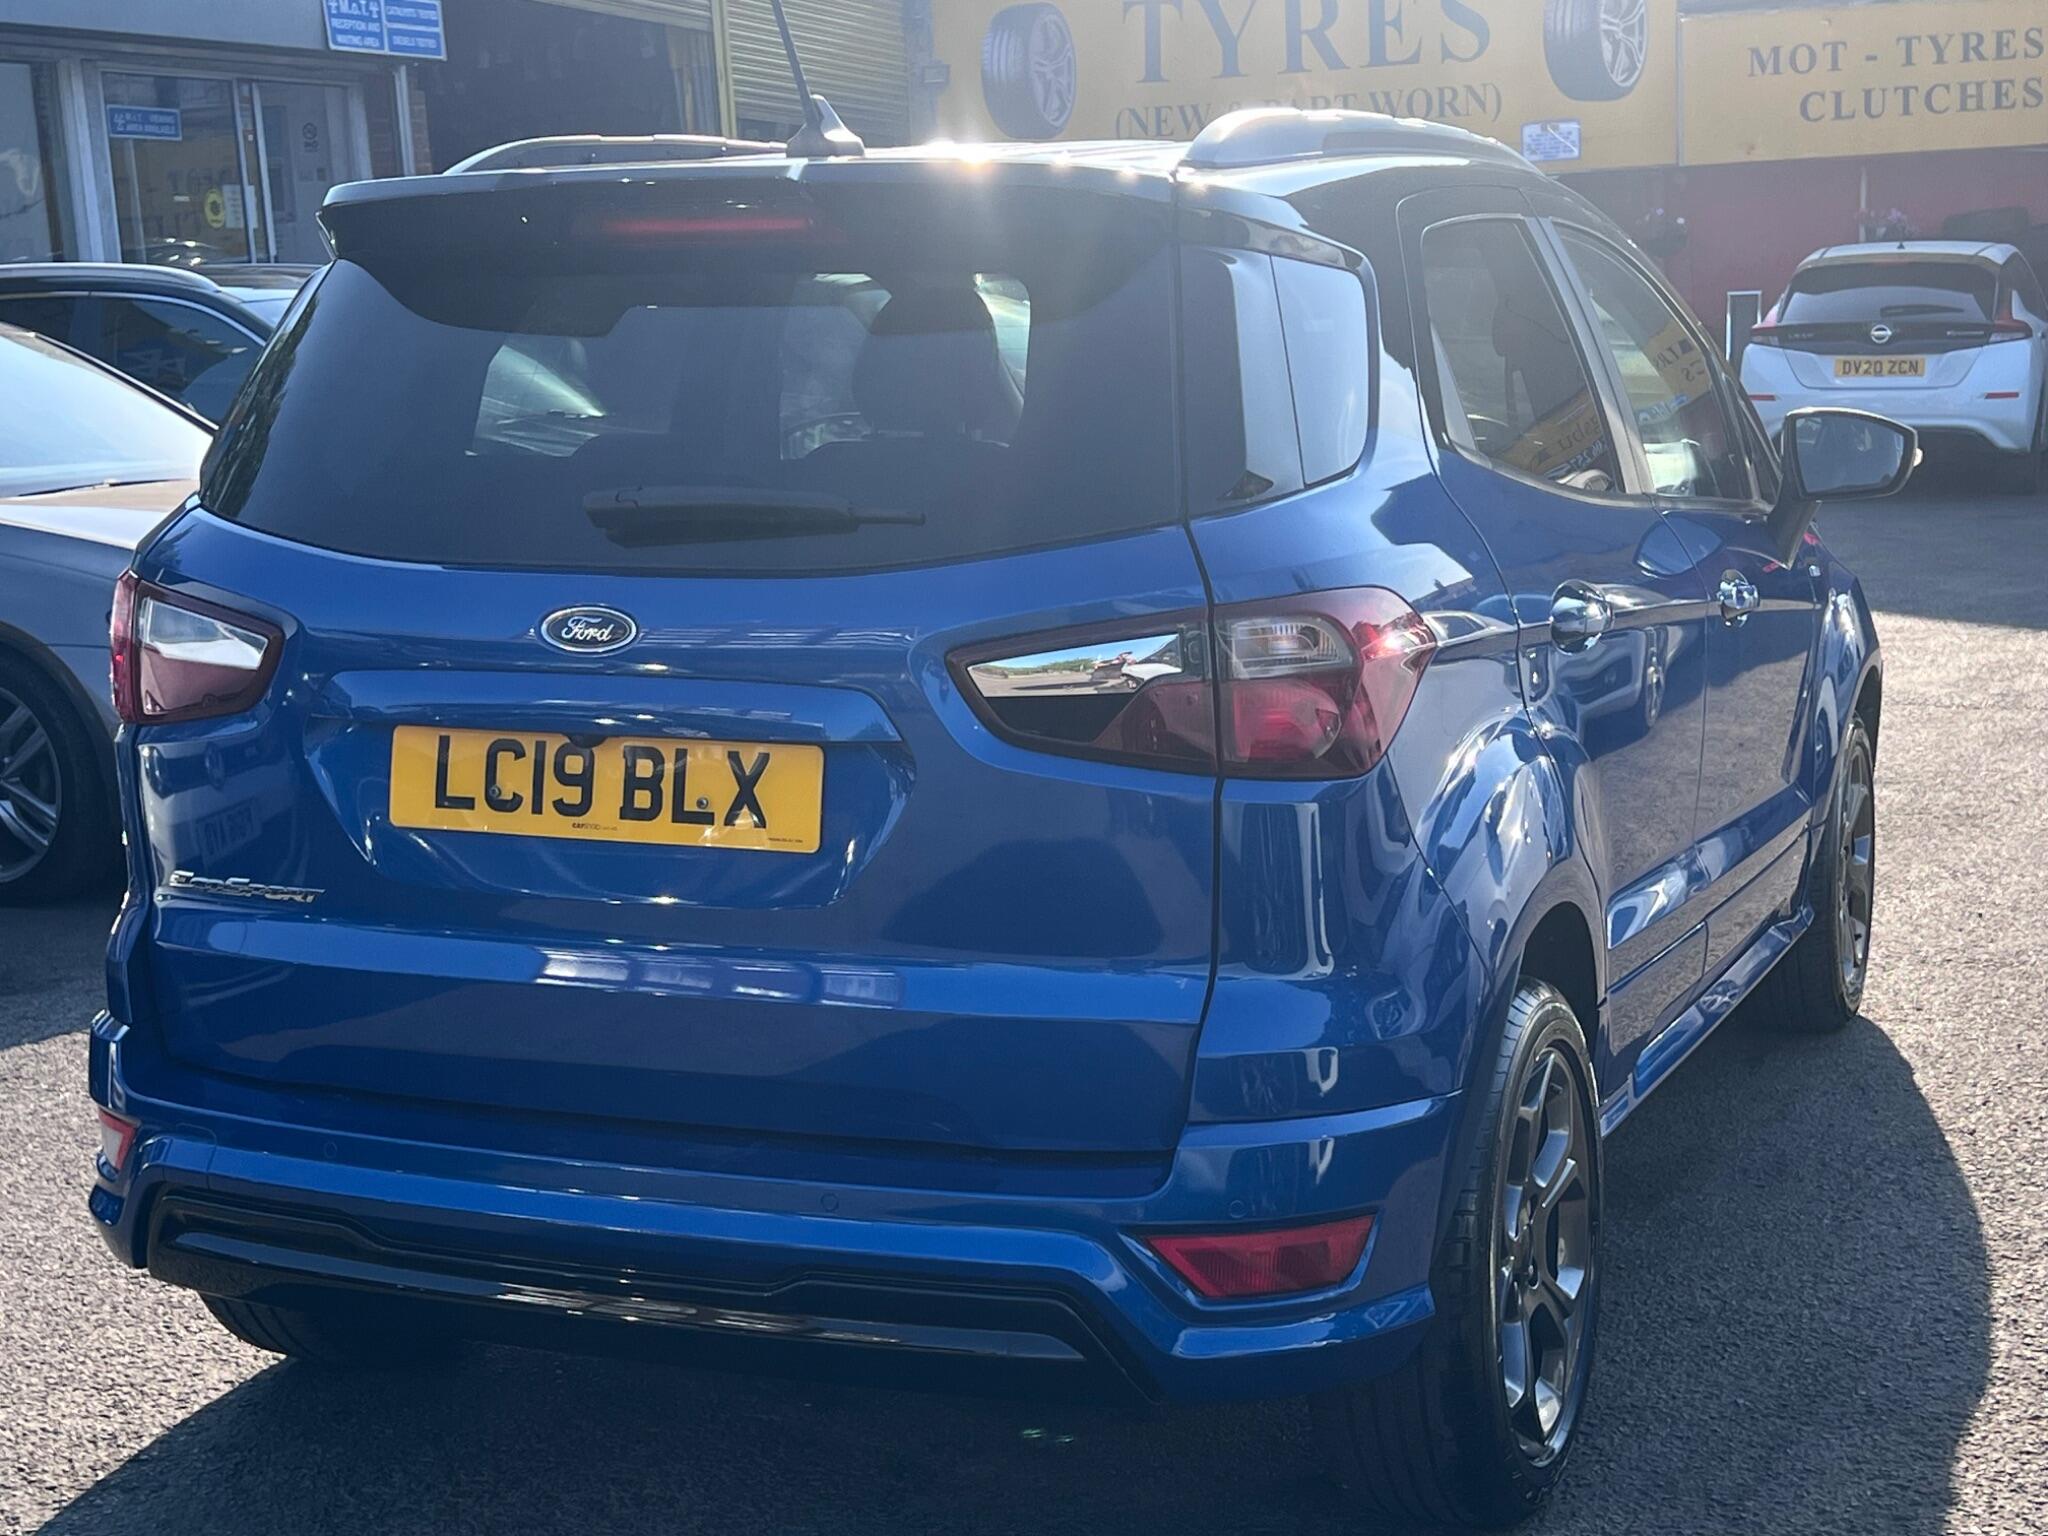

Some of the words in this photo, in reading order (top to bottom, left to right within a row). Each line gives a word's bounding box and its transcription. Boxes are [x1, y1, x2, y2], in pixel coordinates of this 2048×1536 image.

[1122, 0, 1491, 83] TYRES
[1748, 41, 1847, 77] MOT
[1896, 27, 2045, 67] TYRES
[1369, 82, 1502, 122] WORN)
[1800, 77, 2045, 122] CLUTCHES
[1842, 359, 1883, 375] DV20
[1887, 359, 1919, 375] ZCN
[562, 616, 614, 641] Ford
[435, 735, 595, 817] LC19
[620, 746, 770, 828] BLX
